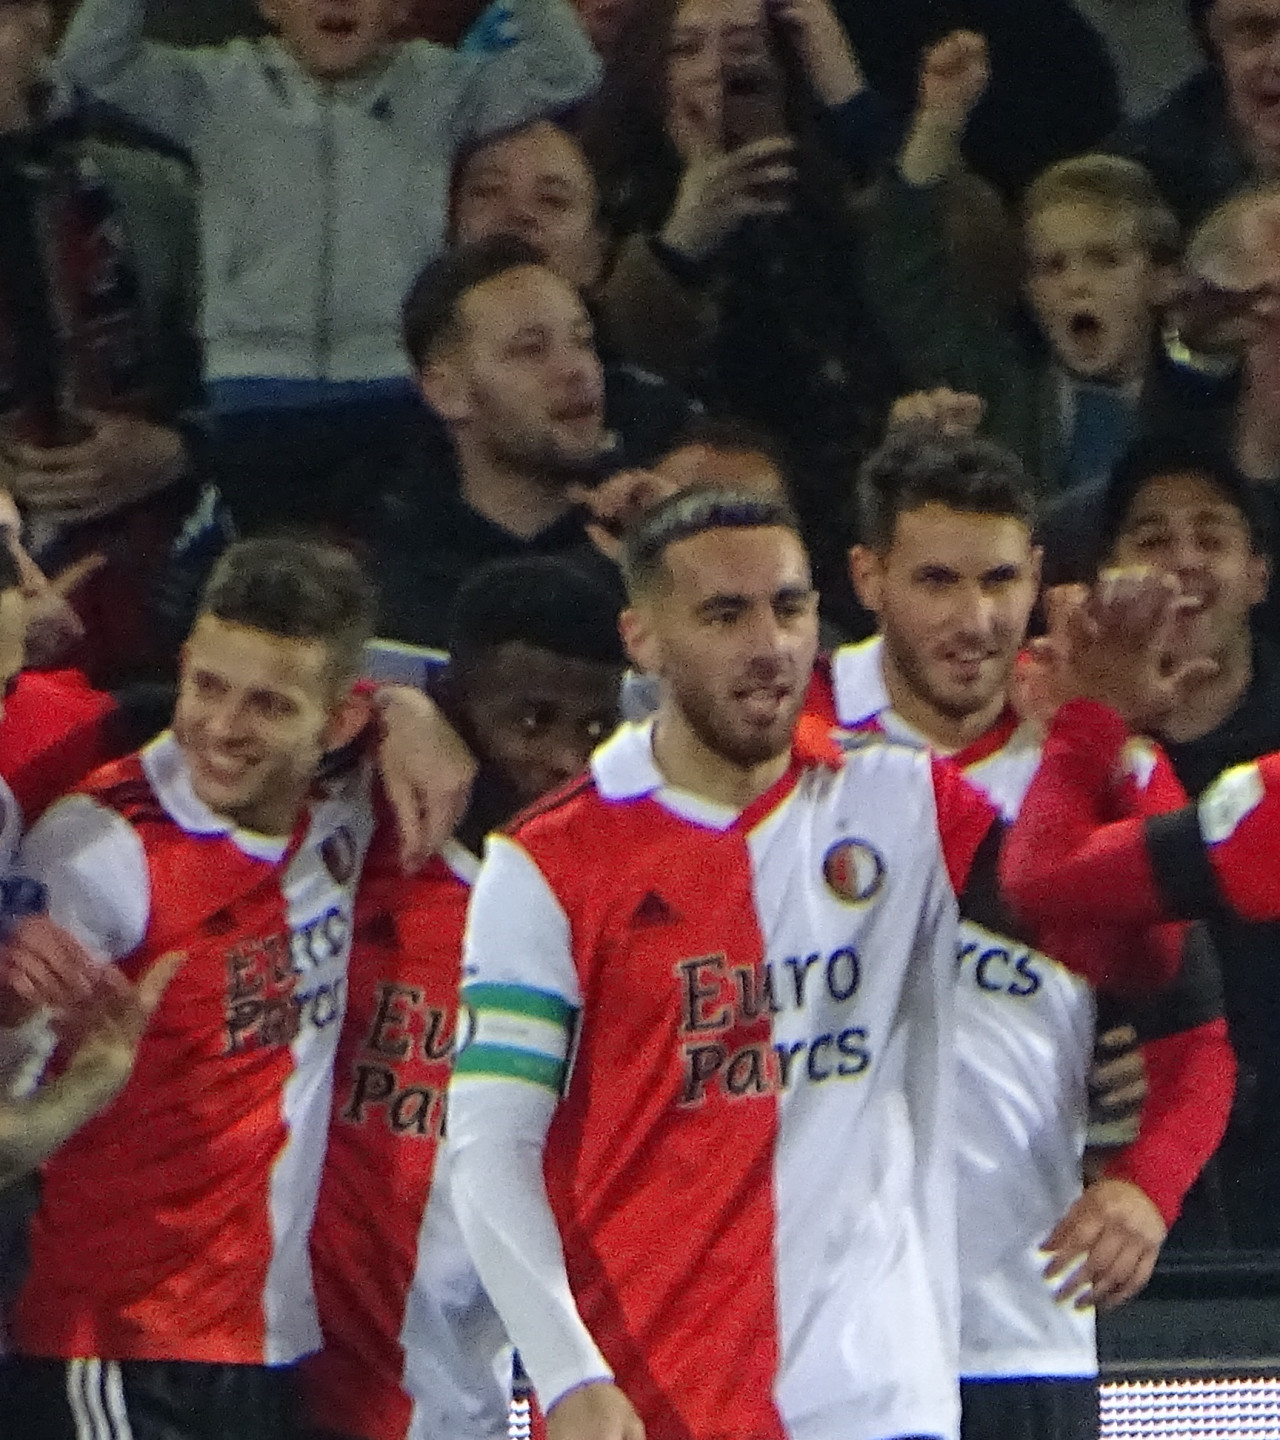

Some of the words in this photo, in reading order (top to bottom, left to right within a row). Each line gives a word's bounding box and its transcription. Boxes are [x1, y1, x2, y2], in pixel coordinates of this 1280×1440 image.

[365, 981, 458, 1062] Eu
[677, 945, 861, 1034] Euro
[675, 1027, 869, 1106] Parcs
